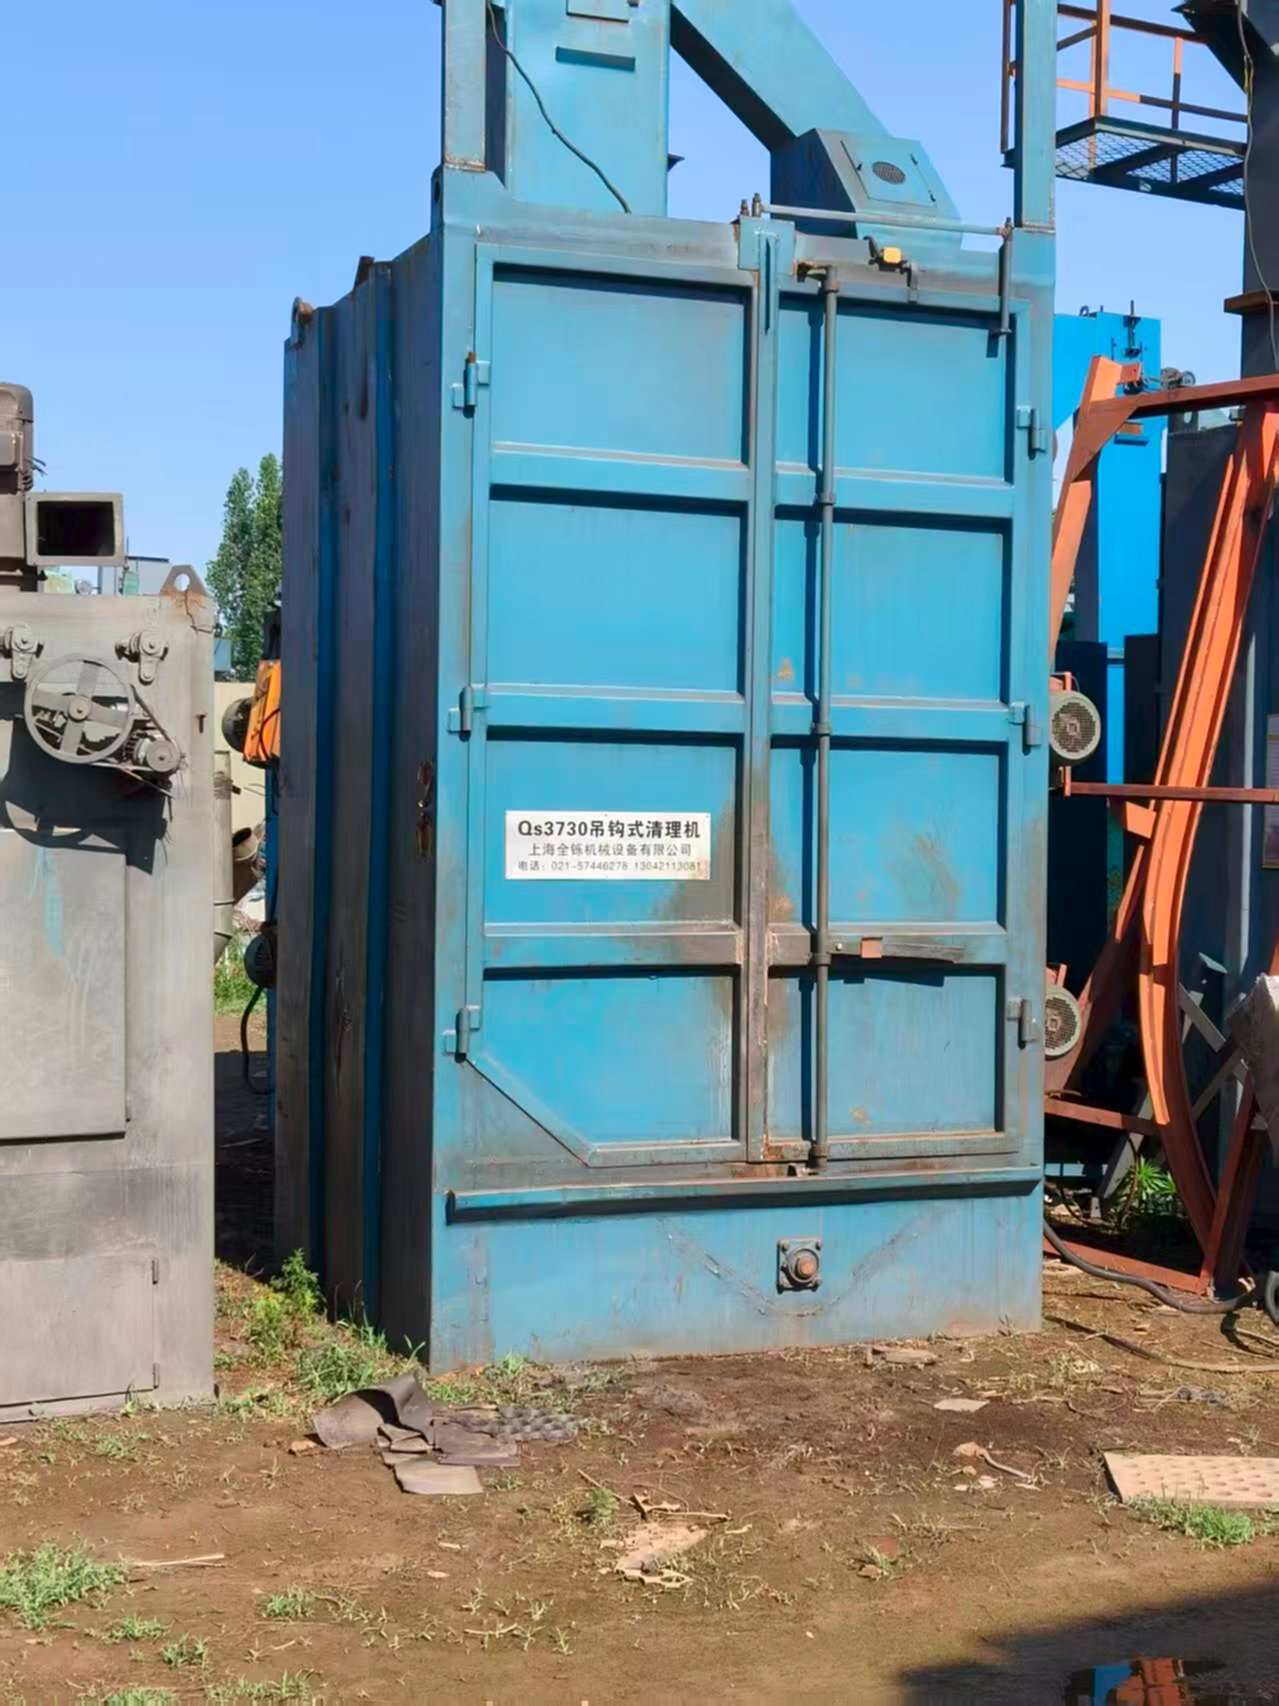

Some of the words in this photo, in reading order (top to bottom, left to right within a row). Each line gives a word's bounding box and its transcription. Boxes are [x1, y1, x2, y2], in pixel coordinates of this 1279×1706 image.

[518, 820, 700, 839] Qs3730吊钩式清理机
